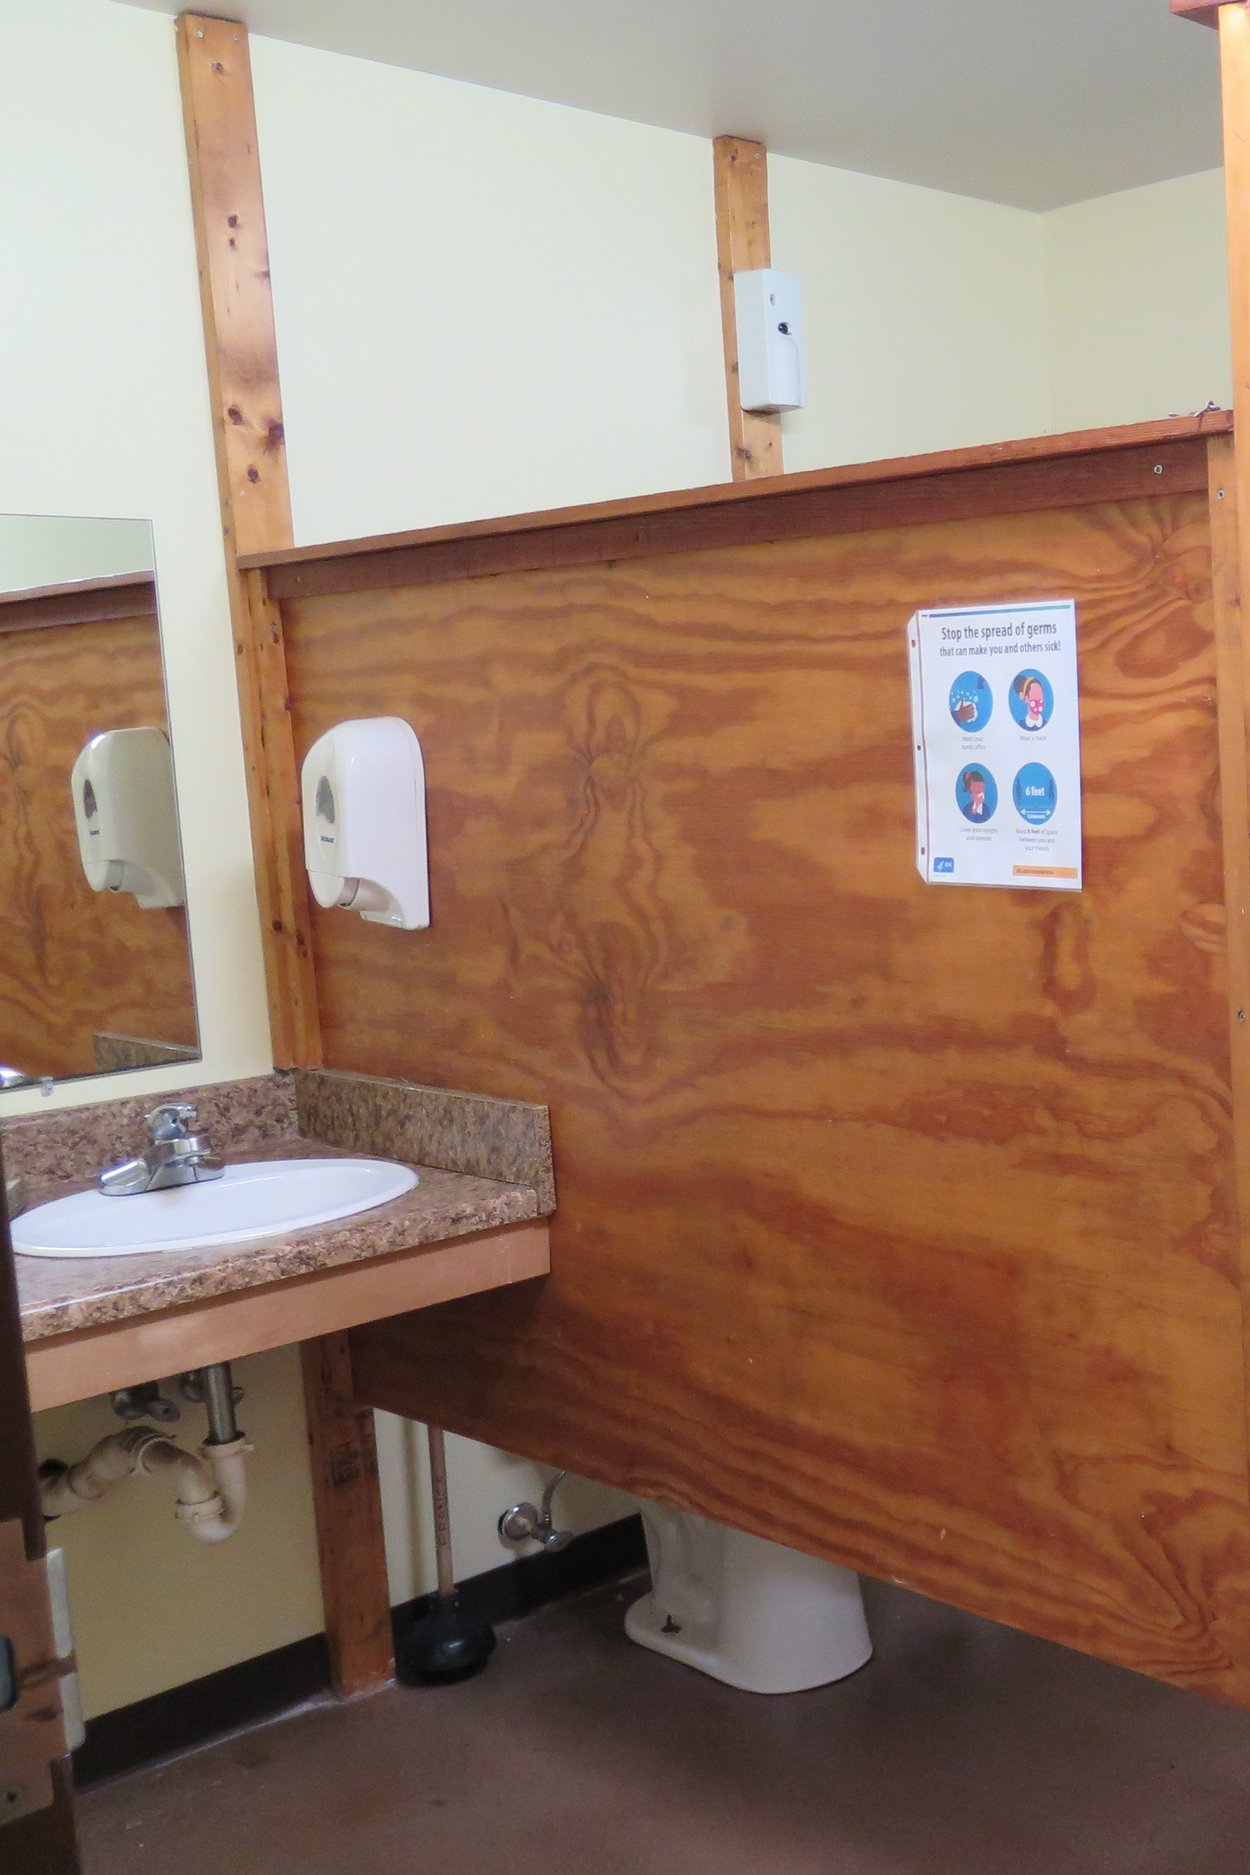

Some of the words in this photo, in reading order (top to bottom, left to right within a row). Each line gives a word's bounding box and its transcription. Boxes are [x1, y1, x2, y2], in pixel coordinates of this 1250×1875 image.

[941, 627, 962, 642] Stop
[964, 625, 979, 639] the
[981, 623, 1013, 641] spread
[1015, 622, 1025, 636] of
[1027, 623, 1057, 639] germs
[939, 646, 954, 657] that
[955, 647, 967, 656] can
[968, 644, 988, 655] make
[989, 646, 1003, 657] you
[1004, 643, 1018, 653] and
[1019, 641, 1043, 653] others
[1044, 640, 1061, 652] sick!
[1025, 786, 1030, 796] 6
[1031, 785, 1045, 796] feet
